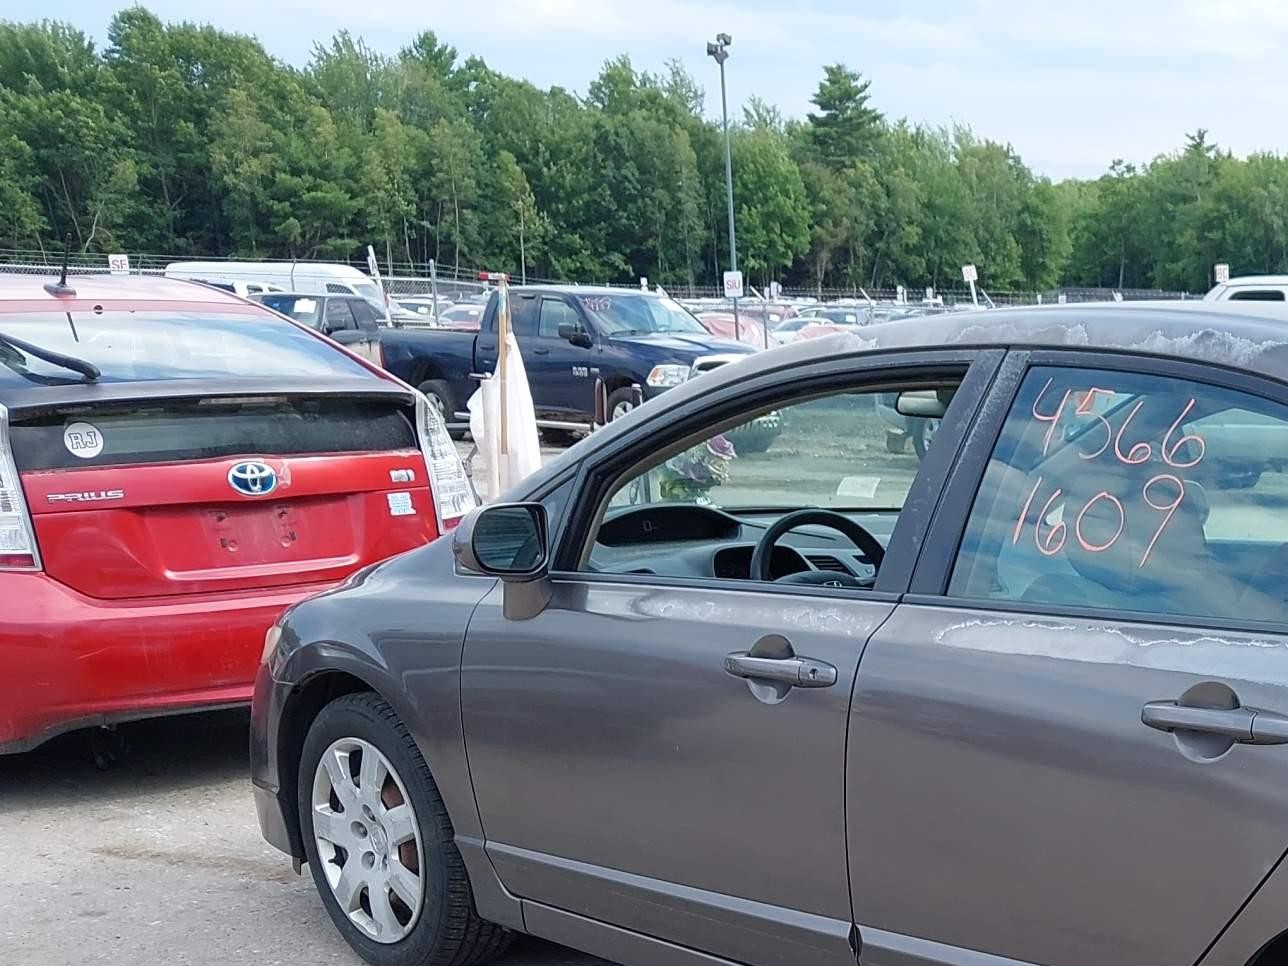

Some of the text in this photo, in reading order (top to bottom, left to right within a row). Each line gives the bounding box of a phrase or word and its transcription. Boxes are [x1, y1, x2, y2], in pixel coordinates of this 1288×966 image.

[111, 259, 127, 270] SF
[1032, 377, 1205, 468] 4566
[68, 431, 98, 450] RJ
[46, 489, 124, 503] PRIUS
[1013, 474, 1185, 568] 1609
